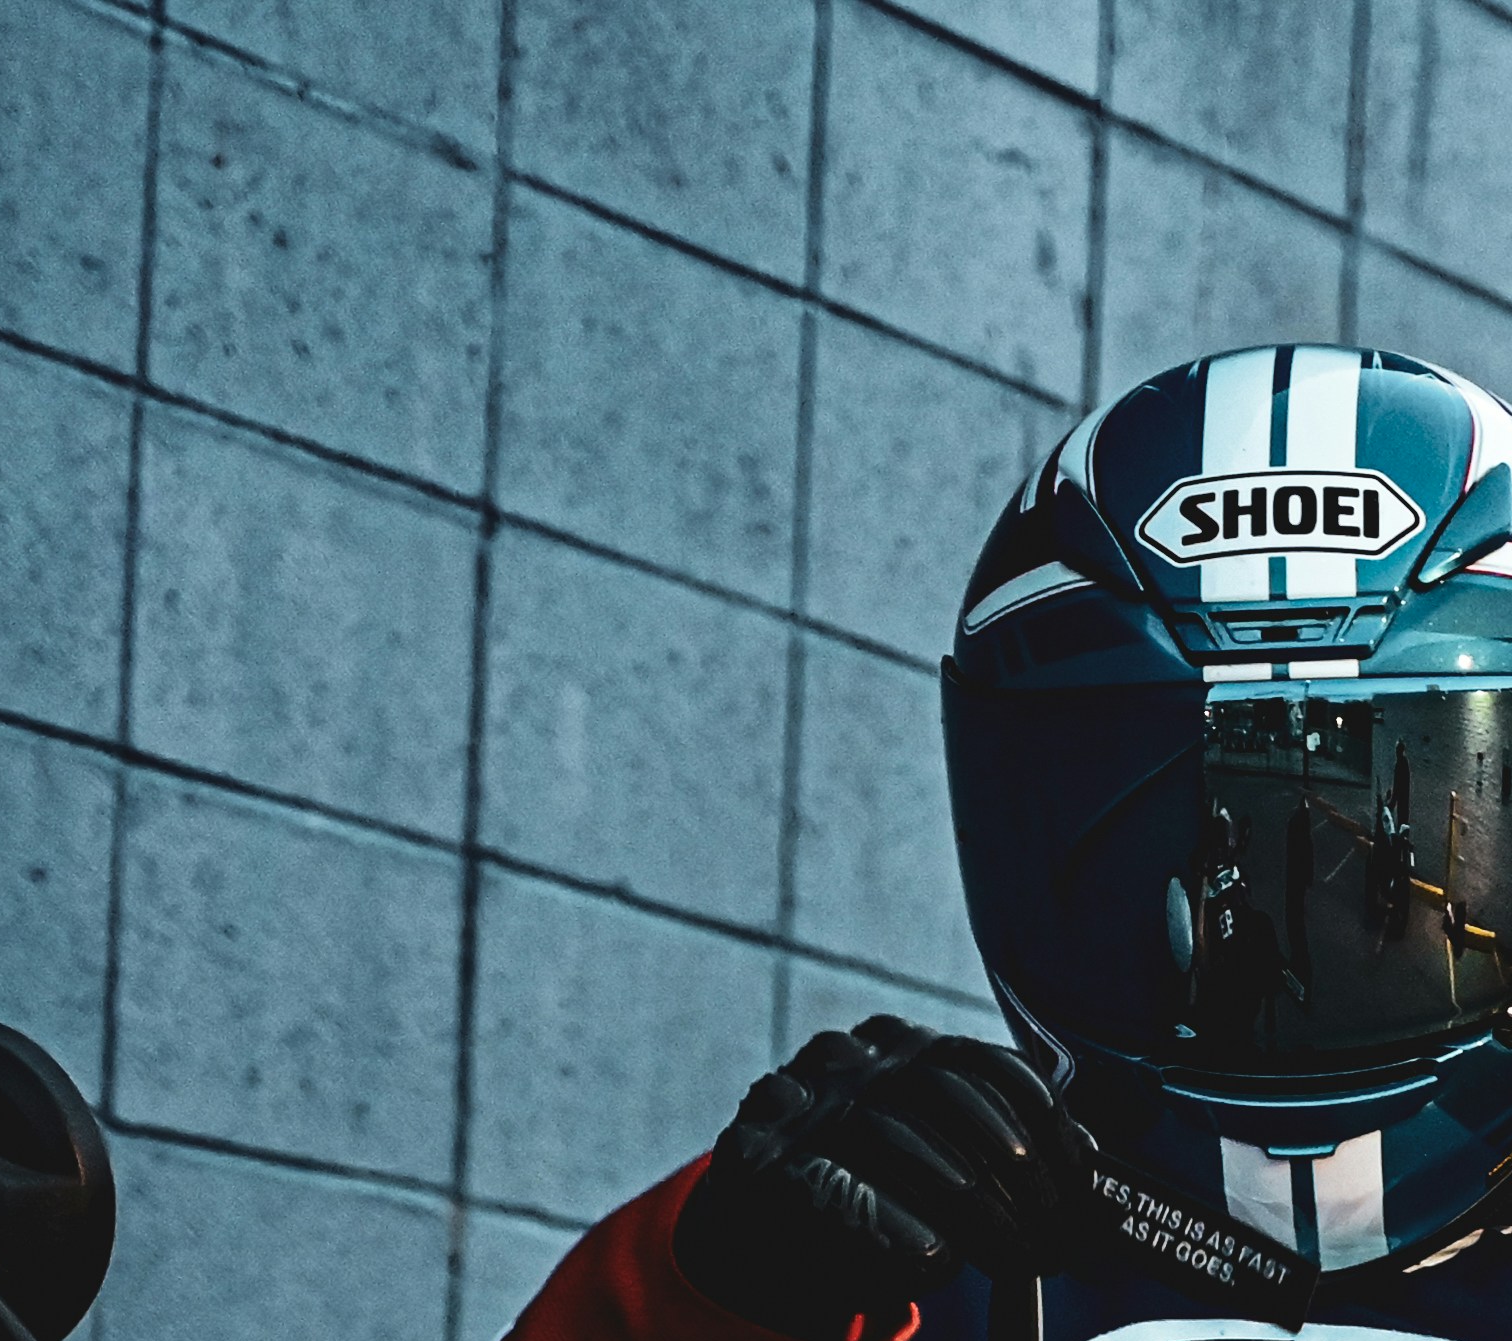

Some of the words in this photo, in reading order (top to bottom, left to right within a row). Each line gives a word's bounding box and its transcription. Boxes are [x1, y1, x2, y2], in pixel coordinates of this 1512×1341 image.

[1179, 485, 1380, 547] SHOEI
[1092, 1169, 1132, 1212] YES,
[1137, 1192, 1183, 1230] THIS
[1184, 1217, 1206, 1242] IS
[1206, 1230, 1235, 1257] AS
[1238, 1245, 1291, 1285] FAST
[1120, 1215, 1150, 1242] AS
[1152, 1229, 1175, 1253] IT
